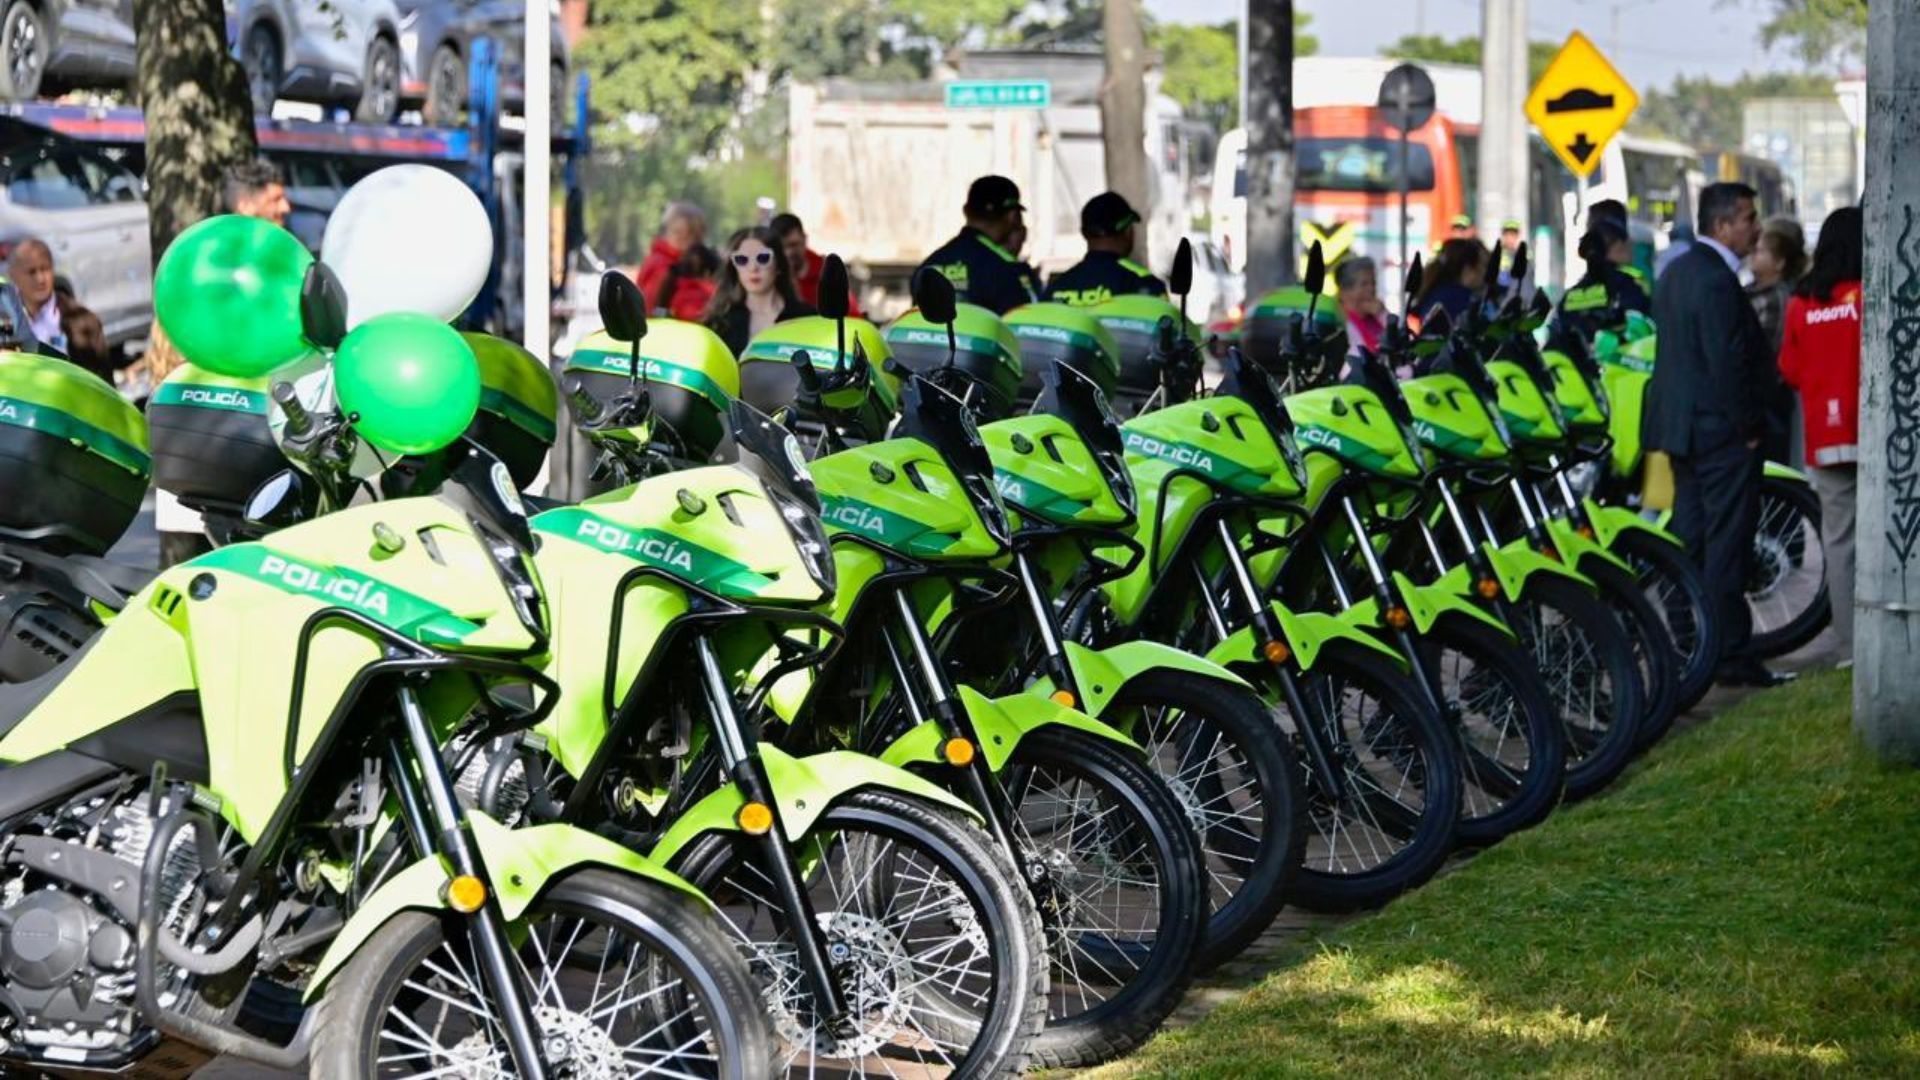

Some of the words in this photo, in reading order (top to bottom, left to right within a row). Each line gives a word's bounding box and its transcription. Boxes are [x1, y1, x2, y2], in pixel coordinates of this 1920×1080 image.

[602, 355, 662, 376] POLCÍA
[181, 389, 251, 409] POLICÍA
[1126, 433, 1214, 473] POLICÍA
[1293, 425, 1342, 452] LICÍA
[819, 500, 884, 535] LICÍA
[576, 518, 693, 572] POLICÍA
[258, 554, 390, 616] POLICÍA
